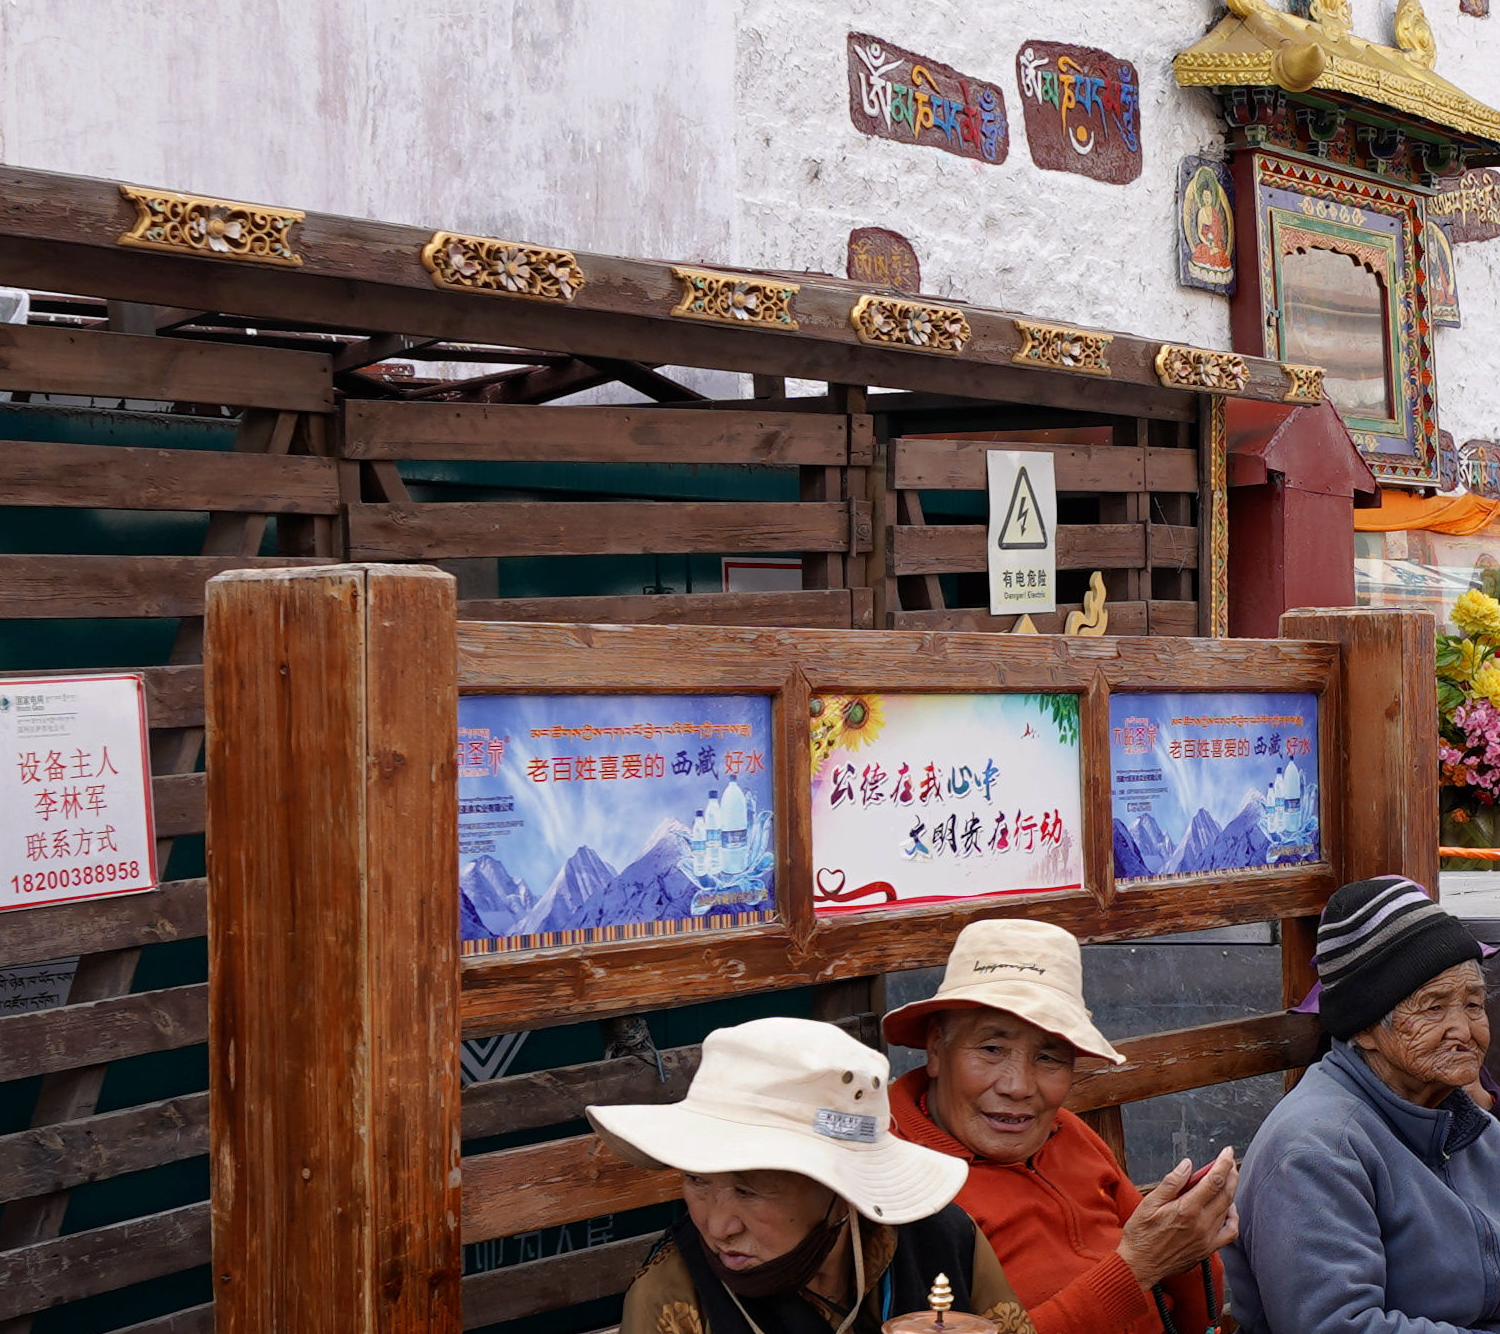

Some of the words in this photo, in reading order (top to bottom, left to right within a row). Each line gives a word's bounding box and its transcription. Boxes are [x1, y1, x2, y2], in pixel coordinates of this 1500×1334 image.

[1002, 569, 1047, 588] 有电危险
[16, 745, 120, 786] 设备主人
[830, 757, 1001, 807] 公德在我心中
[33, 784, 108, 821] 李林军
[25, 824, 118, 862] 联系方式
[904, 808, 1063, 858] 文明贵在行动
[10, 860, 141, 894] 18200388958
[461, 1212, 614, 1277] 业为人民
